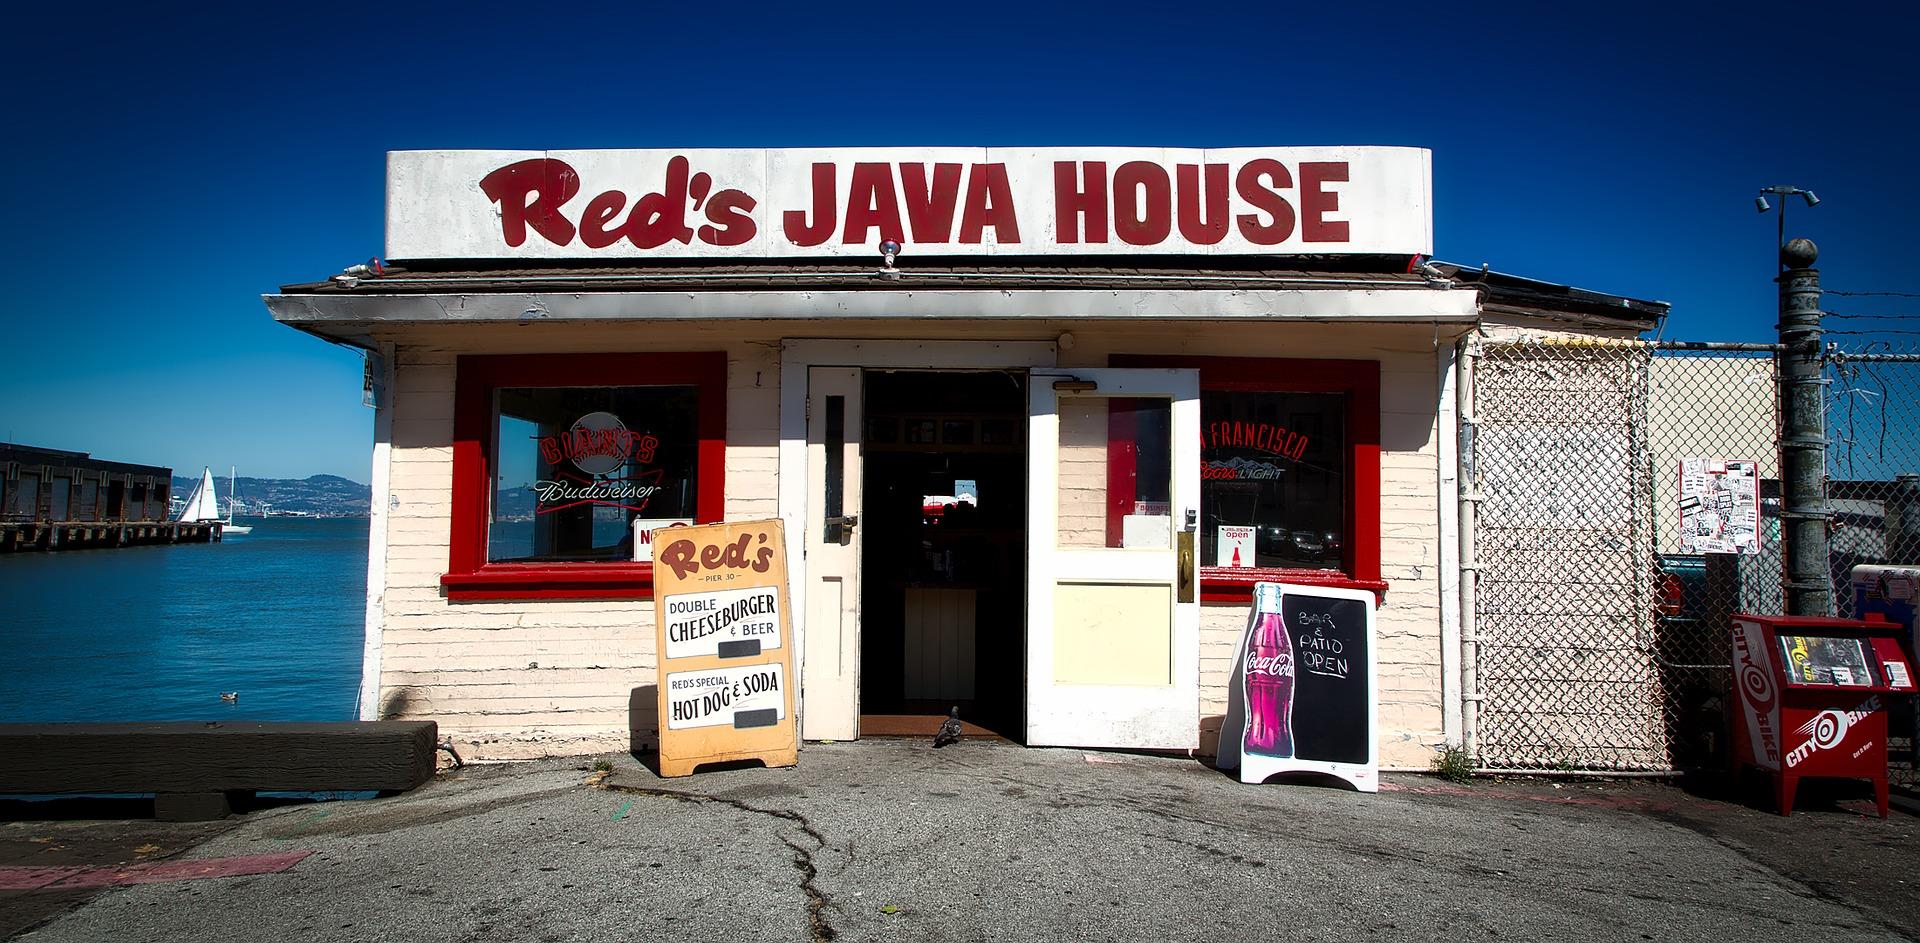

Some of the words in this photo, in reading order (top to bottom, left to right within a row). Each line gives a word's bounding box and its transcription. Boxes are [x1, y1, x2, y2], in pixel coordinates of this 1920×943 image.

[481, 156, 757, 250] Red's
[783, 162, 1021, 247] JAVA
[1053, 160, 1350, 246] HOUSE
[540, 428, 660, 465] GIANTS
[1210, 419, 1309, 462] FRANCISCO
[1238, 467, 1285, 480] LIGHT
[533, 480, 662, 502] Budweiser
[1225, 531, 1249, 539] open
[660, 533, 774, 581] Red's
[705, 574, 722, 582] PIER
[725, 573, 735, 581] 30
[669, 599, 717, 614] DOUBLE
[669, 594, 776, 643] CHEESEBURGER
[743, 622, 775, 636] BEER
[1298, 611, 1336, 629] BAR
[1300, 633, 1343, 654] PATIO
[1302, 651, 1349, 675] OPEN
[672, 678, 695, 690] RED'S
[696, 676, 730, 688] SPECIAL
[1732, 622, 1753, 667] CITY
[1755, 711, 1780, 763] BIKE
[672, 698, 700, 721] HOT
[703, 686, 731, 717] DOG
[743, 671, 779, 697] SODA
[1785, 736, 1817, 768] CITY
[1845, 694, 1882, 727] BIKE
